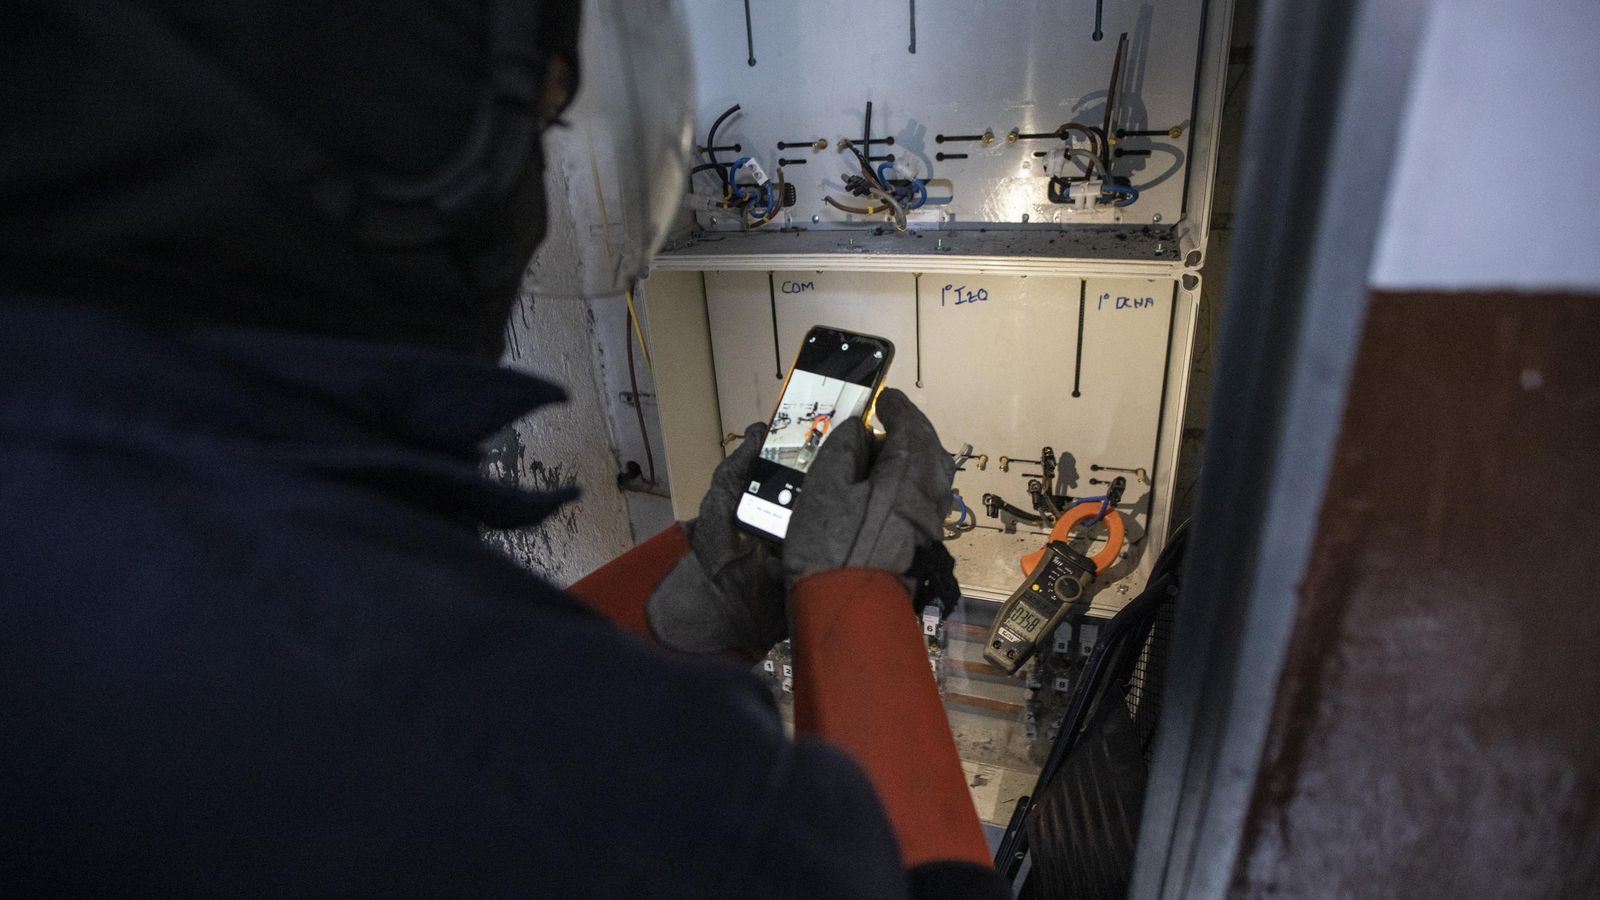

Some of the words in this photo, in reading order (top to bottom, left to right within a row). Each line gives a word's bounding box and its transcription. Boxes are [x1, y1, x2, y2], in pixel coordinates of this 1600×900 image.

[781, 280, 815, 294] COM
[1115, 296, 1154, 310] DCHA
[926, 624, 934, 633] 6
